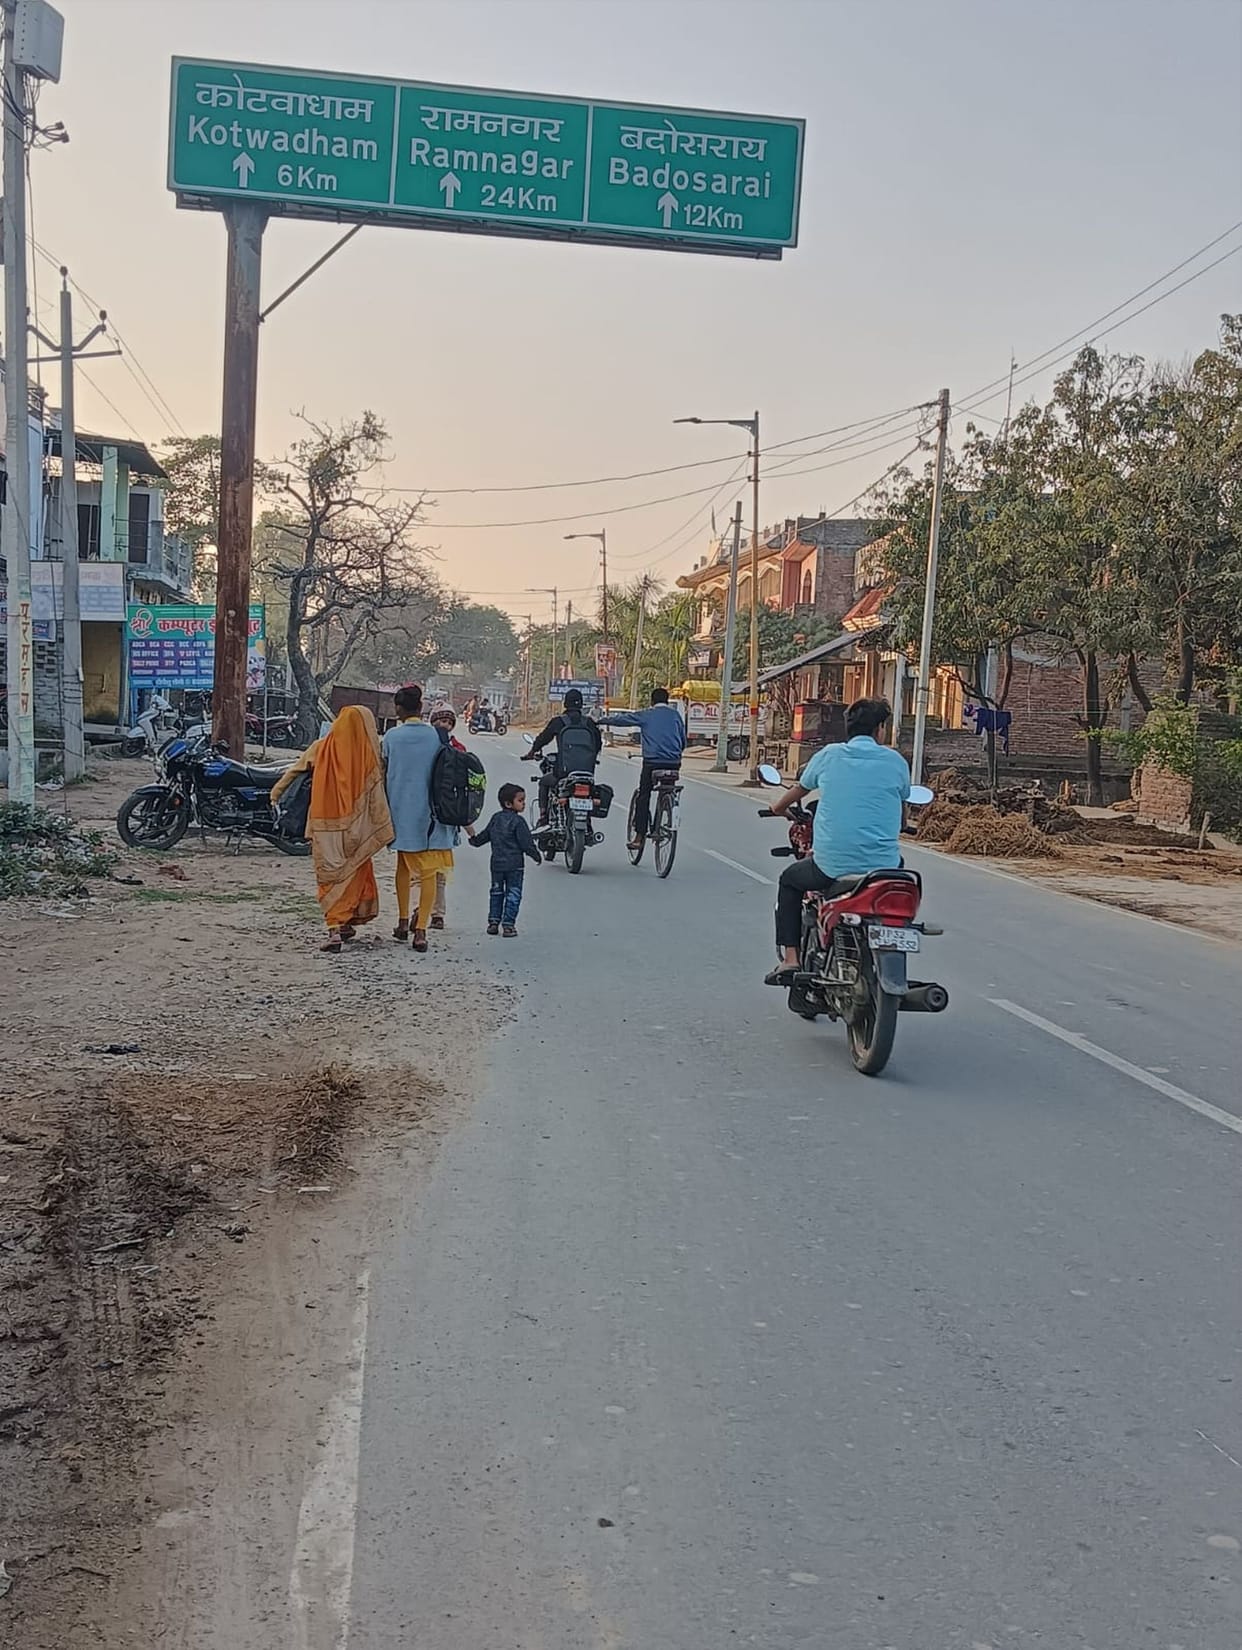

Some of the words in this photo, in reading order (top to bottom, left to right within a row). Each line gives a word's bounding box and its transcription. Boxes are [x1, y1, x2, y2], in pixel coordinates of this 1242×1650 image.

[195, 73, 375, 123] कोटवाधाम
[188, 114, 378, 161] Kotwadham
[420, 105, 565, 142] रामनगर
[620, 119, 768, 161] बदोसराय
[410, 137, 574, 180] Ramnagar
[609, 157, 771, 199] Badosarai
[480, 184, 557, 212] 24Km
[683, 203, 744, 230] 12Km
[705, 707, 718, 717] ALL
